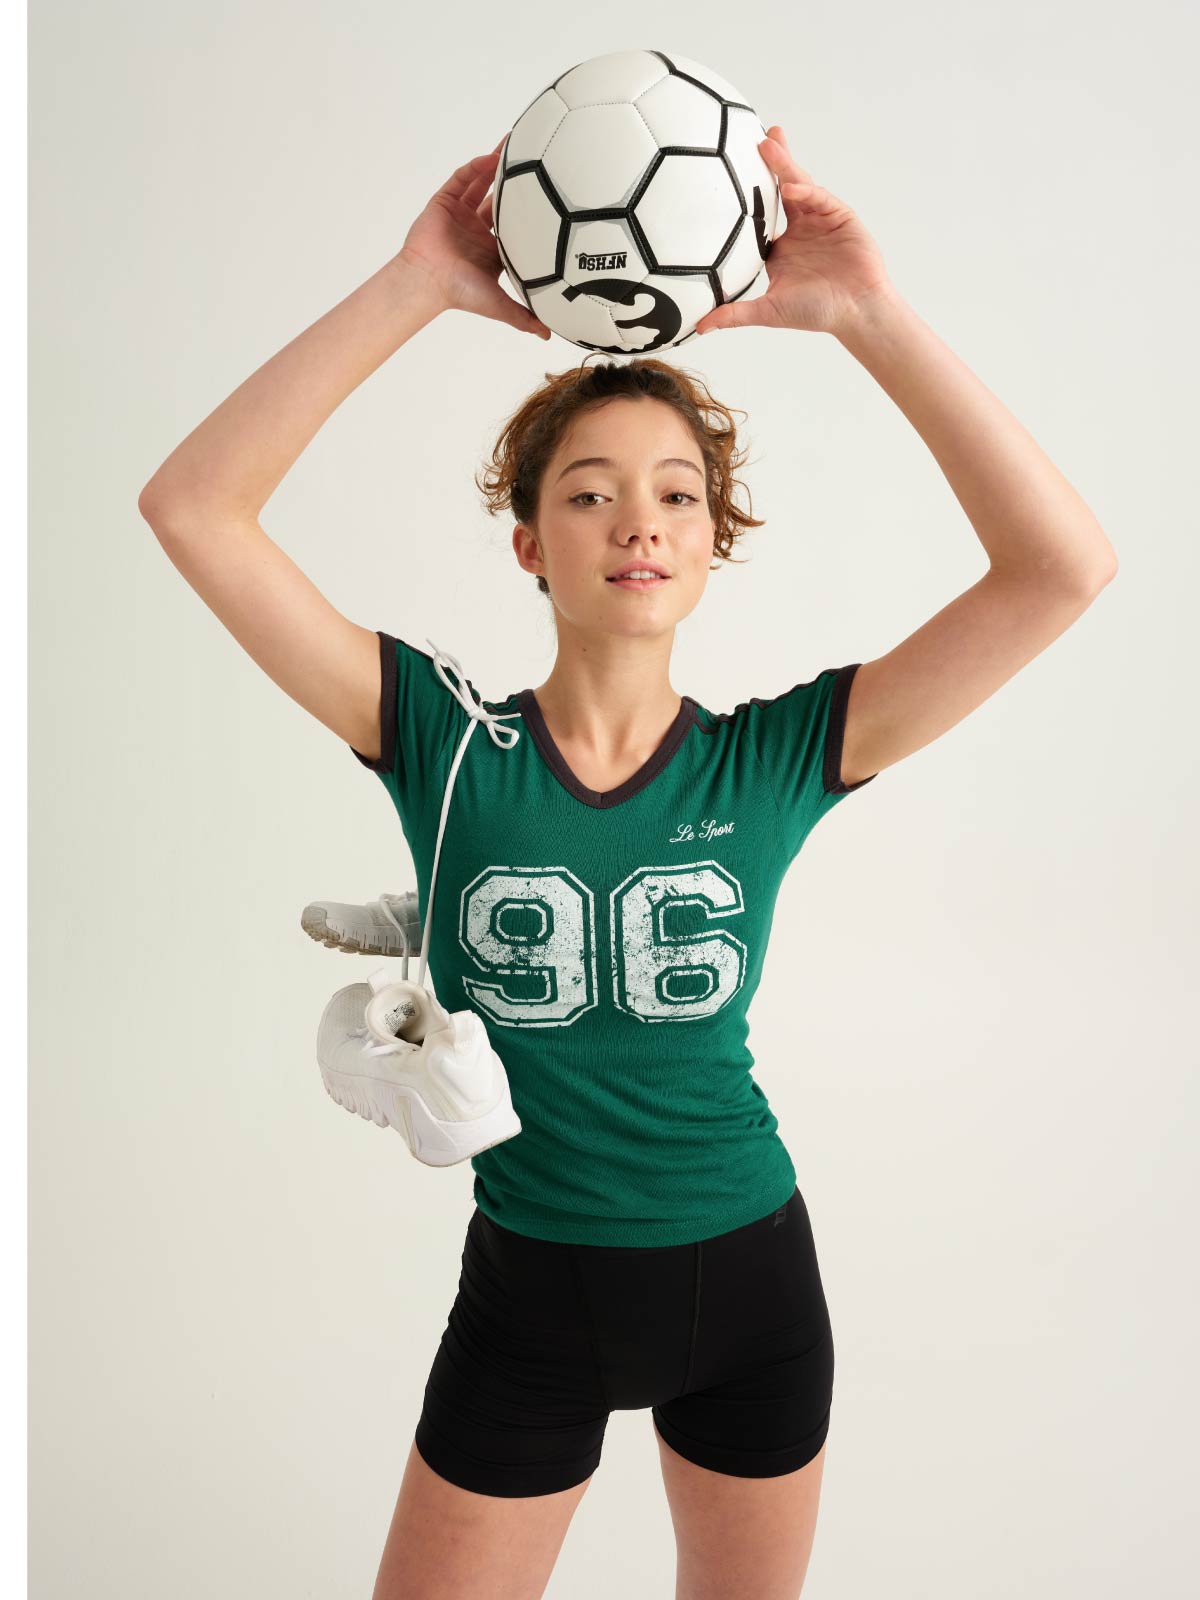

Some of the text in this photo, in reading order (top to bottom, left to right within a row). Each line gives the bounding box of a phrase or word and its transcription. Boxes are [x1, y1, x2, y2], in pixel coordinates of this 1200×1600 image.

[669, 819, 736, 843] Le Sport
[458, 860, 748, 1028] 96
